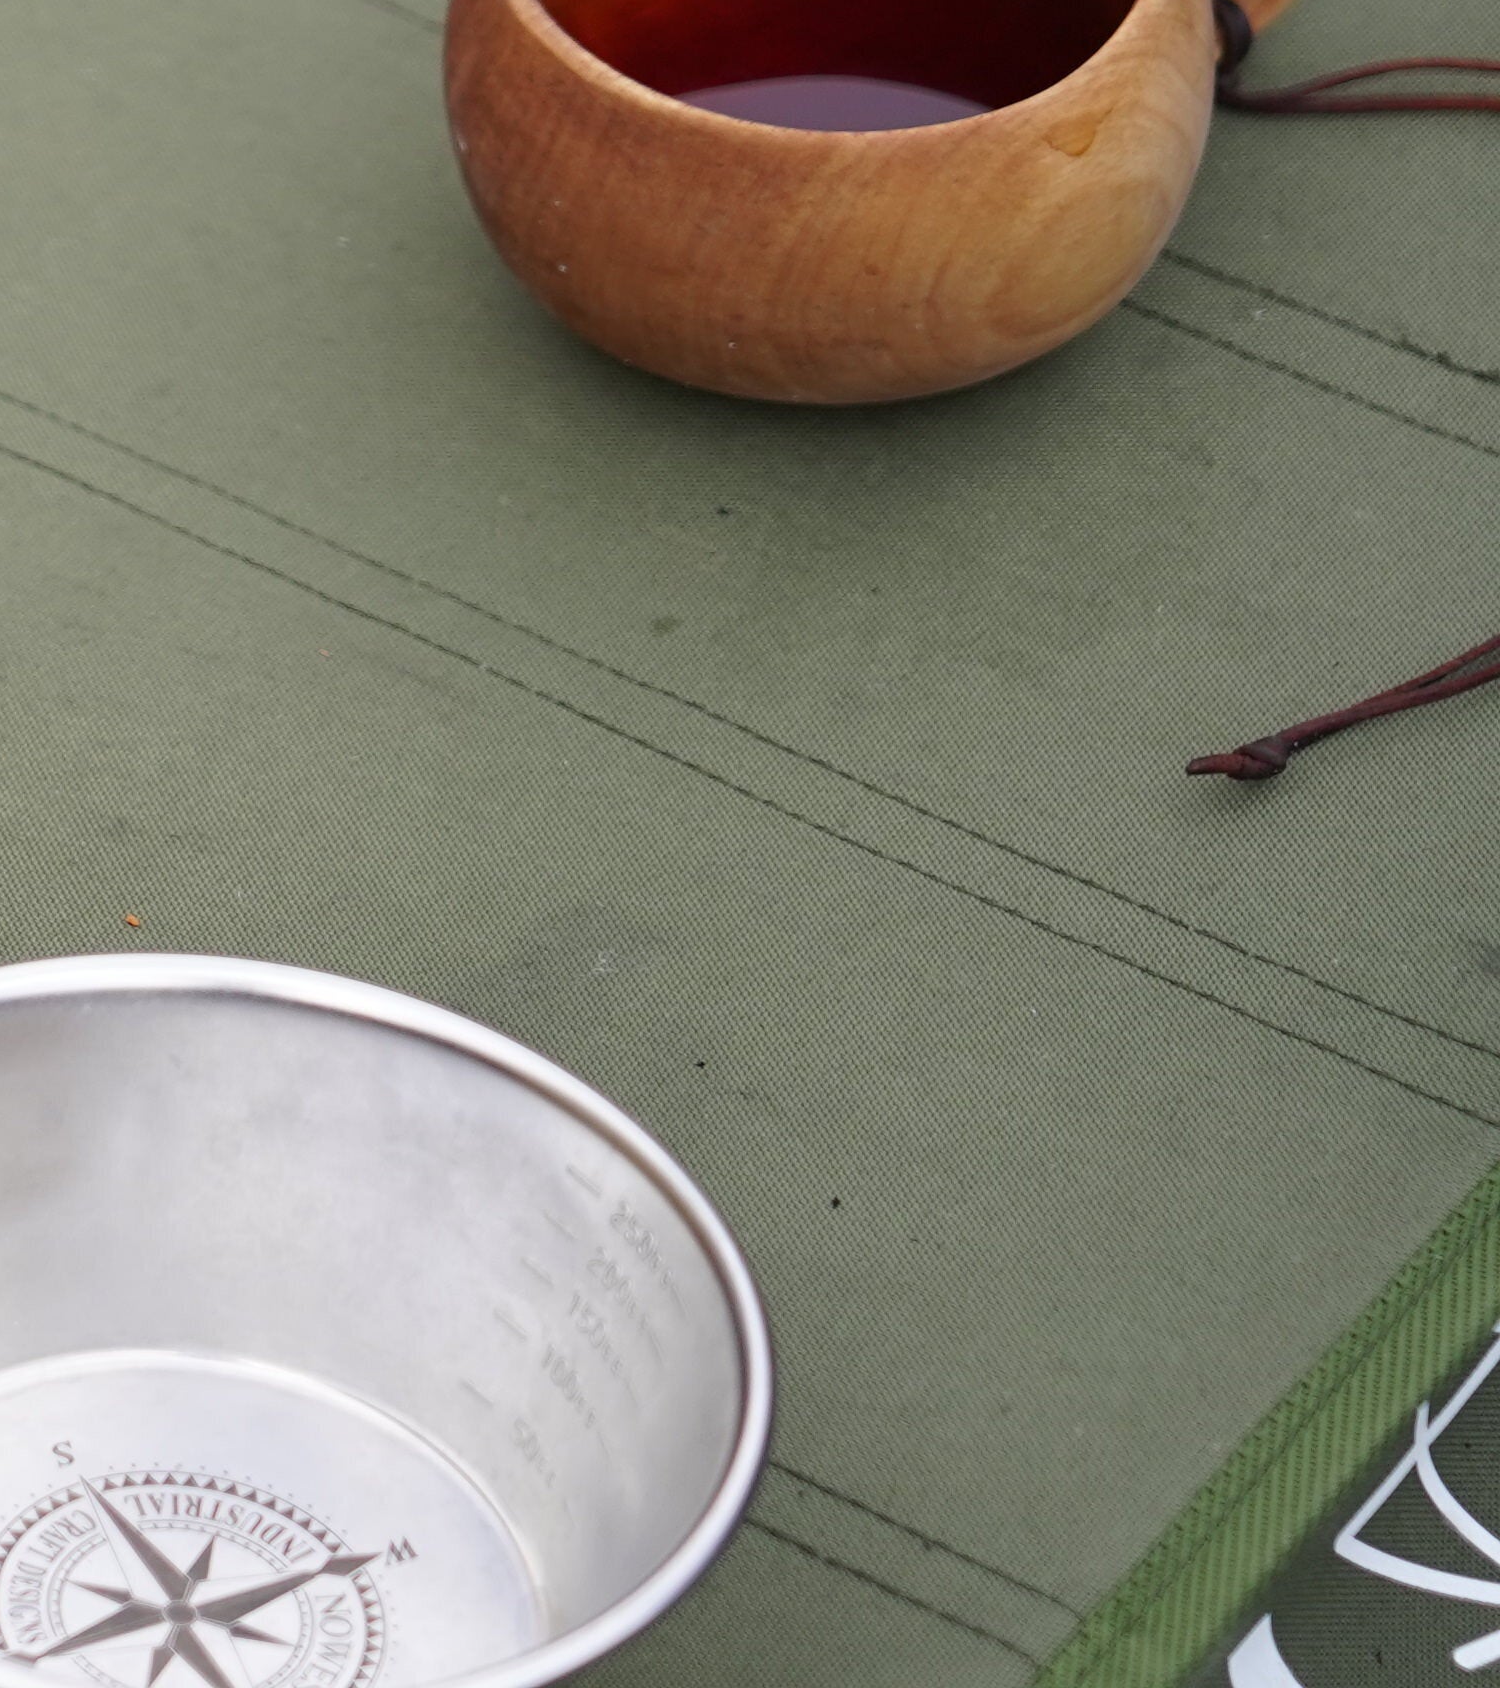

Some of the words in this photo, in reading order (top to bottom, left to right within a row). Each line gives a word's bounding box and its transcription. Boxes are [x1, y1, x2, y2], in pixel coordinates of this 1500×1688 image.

[51, 1439, 76, 1469] S
[26, 1510, 98, 1563] CRAFT
[124, 1491, 315, 1564] INDUSTRIAL
[384, 1534, 419, 1567] W
[7, 1561, 50, 1645] DESIGNS
